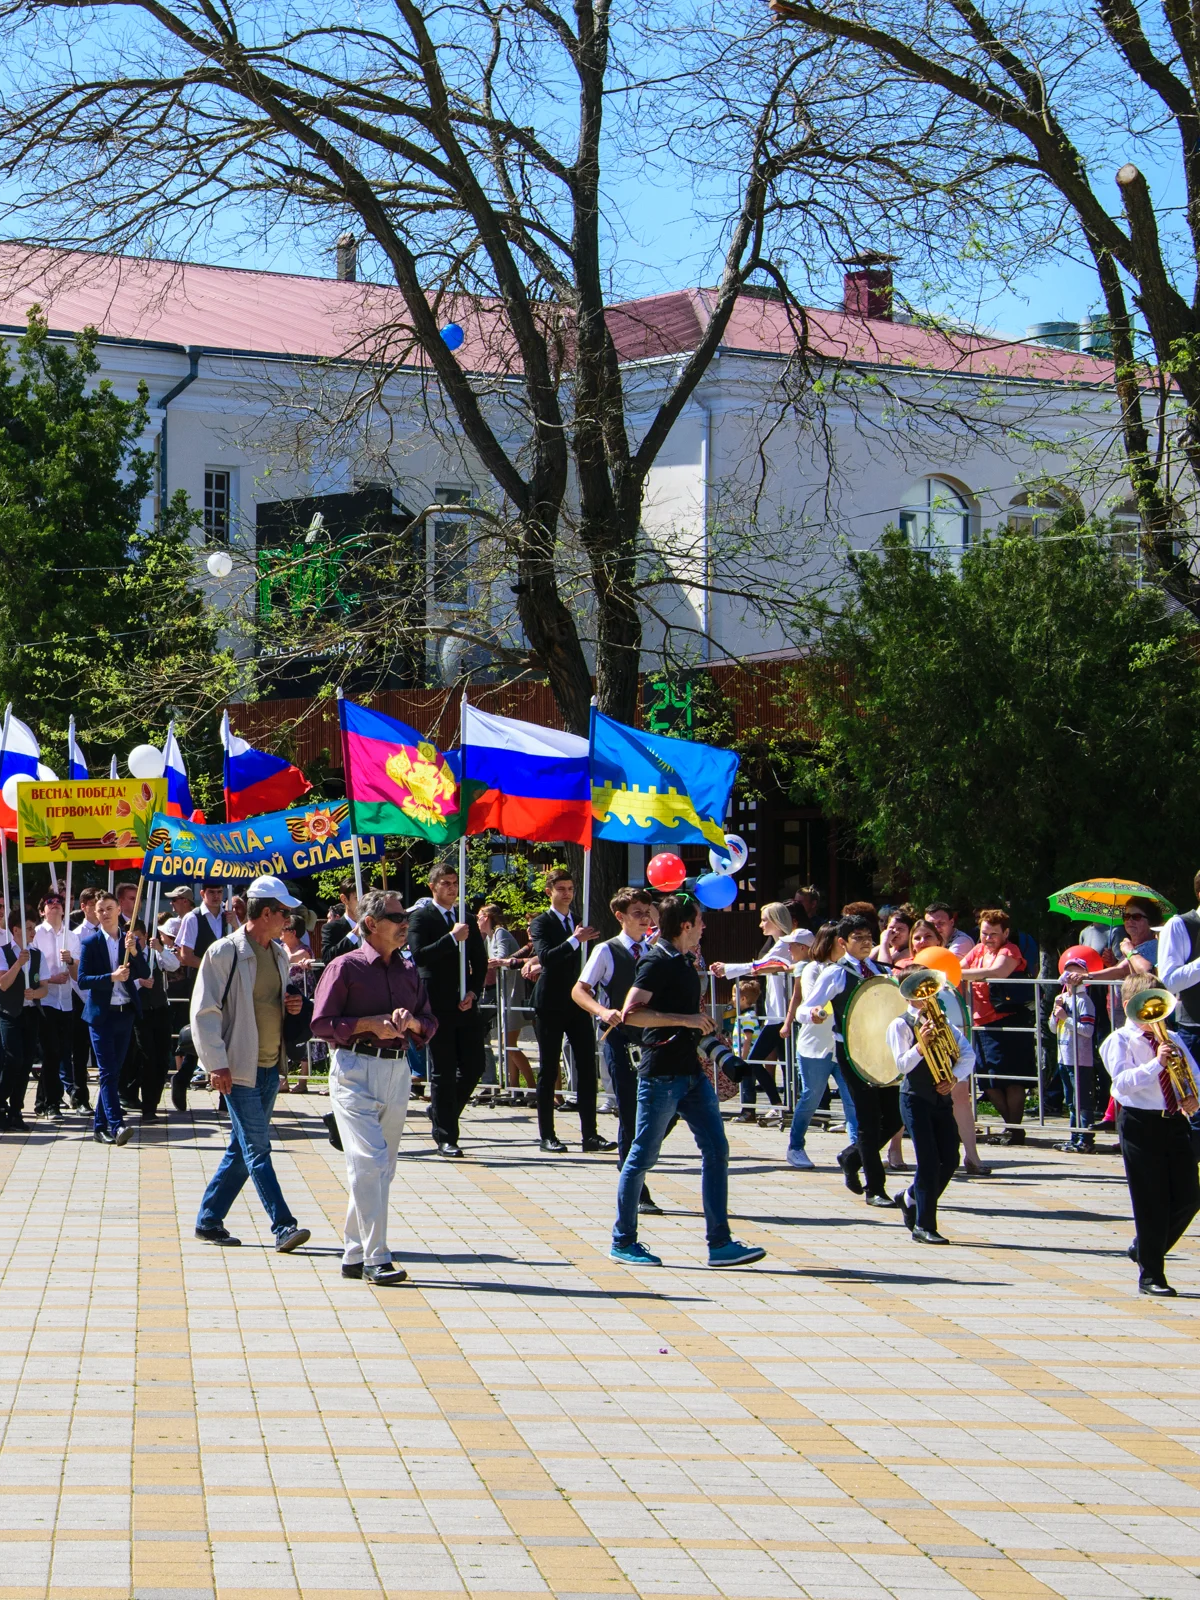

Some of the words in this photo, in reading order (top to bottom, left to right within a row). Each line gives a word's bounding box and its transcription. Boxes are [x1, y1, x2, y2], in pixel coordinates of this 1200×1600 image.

[650, 680, 692, 730] 24
[31, 788, 73, 800] ВЕСНА!
[77, 786, 126, 799] ПОБЕДА!
[46, 803, 112, 818] ПЕРВОМАЙ!
[149, 855, 208, 880] ГОРОД
[210, 851, 288, 878] ВОИНСКОЙ
[292, 836, 377, 868] СЛАВЫ
